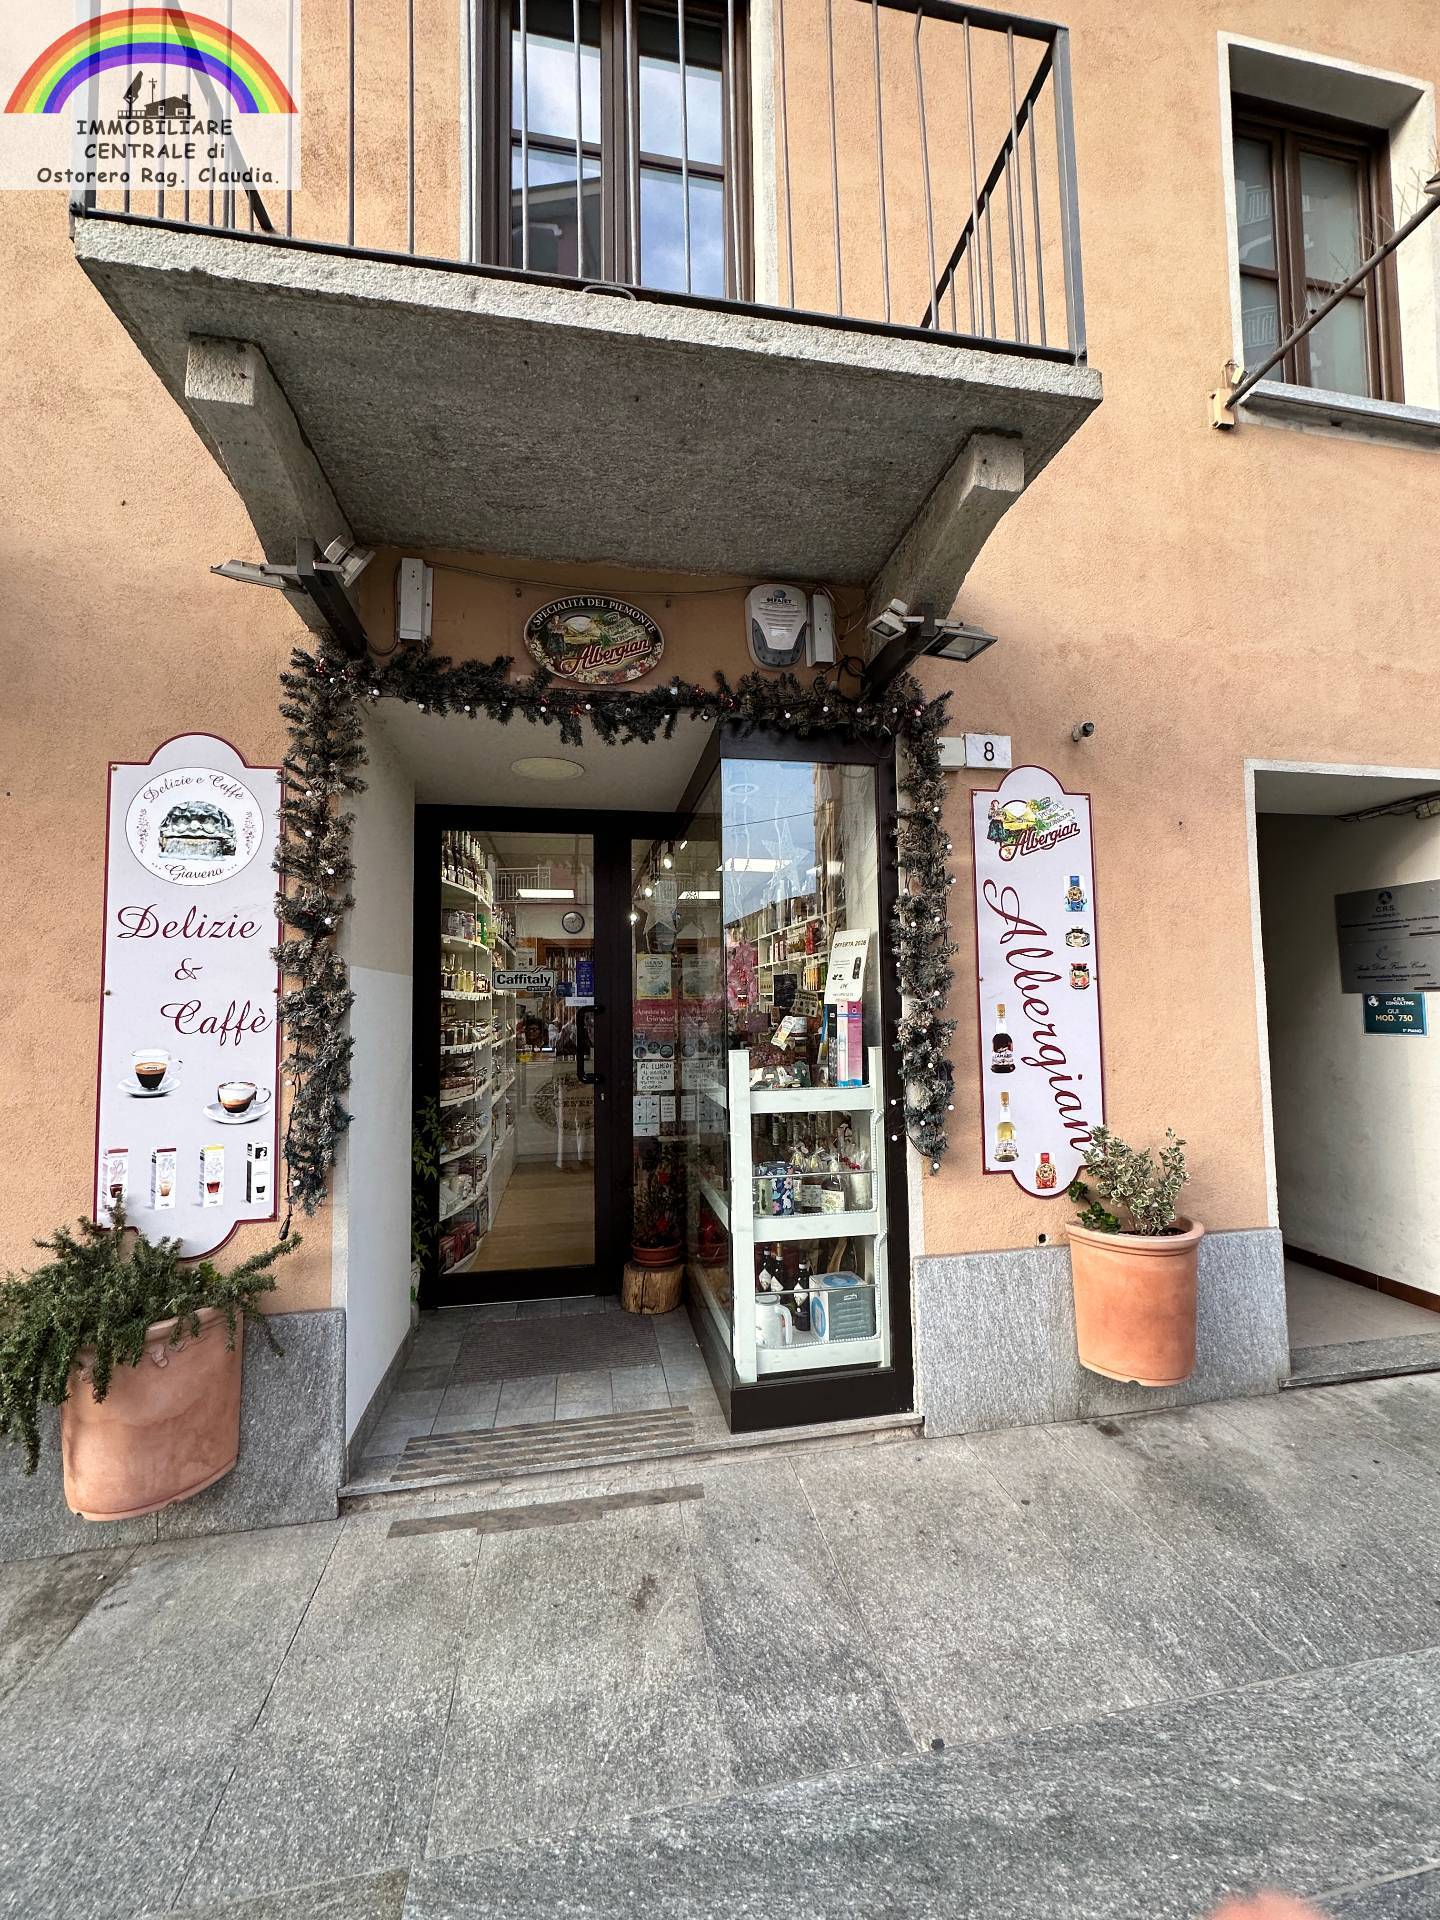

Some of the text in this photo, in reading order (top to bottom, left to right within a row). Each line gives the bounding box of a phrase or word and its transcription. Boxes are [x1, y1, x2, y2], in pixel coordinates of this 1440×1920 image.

[587, 598, 608, 608] DEL
[609, 601, 657, 633] PIEMONTE
[560, 639, 652, 676] Albergian
[983, 741, 995, 761] 8
[143, 775, 194, 803] Delizie
[209, 774, 244, 799] Caffè
[998, 822, 1081, 862] Albergian
[165, 864, 225, 881] Giaveno
[117, 904, 262, 939] Delizie
[174, 958, 203, 981] &
[496, 974, 551, 986] Caffitaly
[160, 1000, 273, 1046] Caffè
[982, 878, 1093, 1152] Albergian
[1375, 1014, 1413, 1022] MOD. 730
